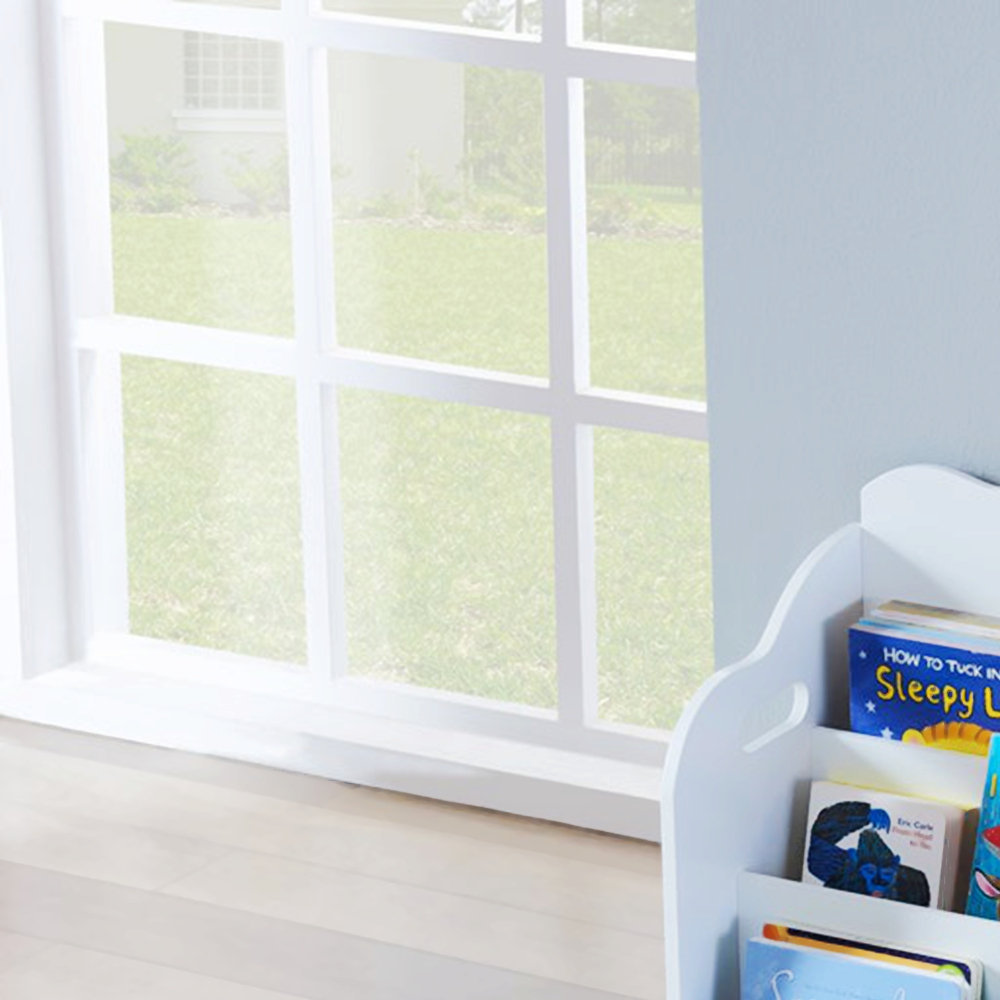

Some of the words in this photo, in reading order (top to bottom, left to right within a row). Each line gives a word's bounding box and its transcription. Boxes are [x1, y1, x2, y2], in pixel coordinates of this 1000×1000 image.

[884, 647, 920, 667] HOW
[923, 655, 943, 671] TO
[946, 659, 983, 678] TUCK
[876, 665, 974, 719] Sleepy
[989, 774, 998, 798] I
